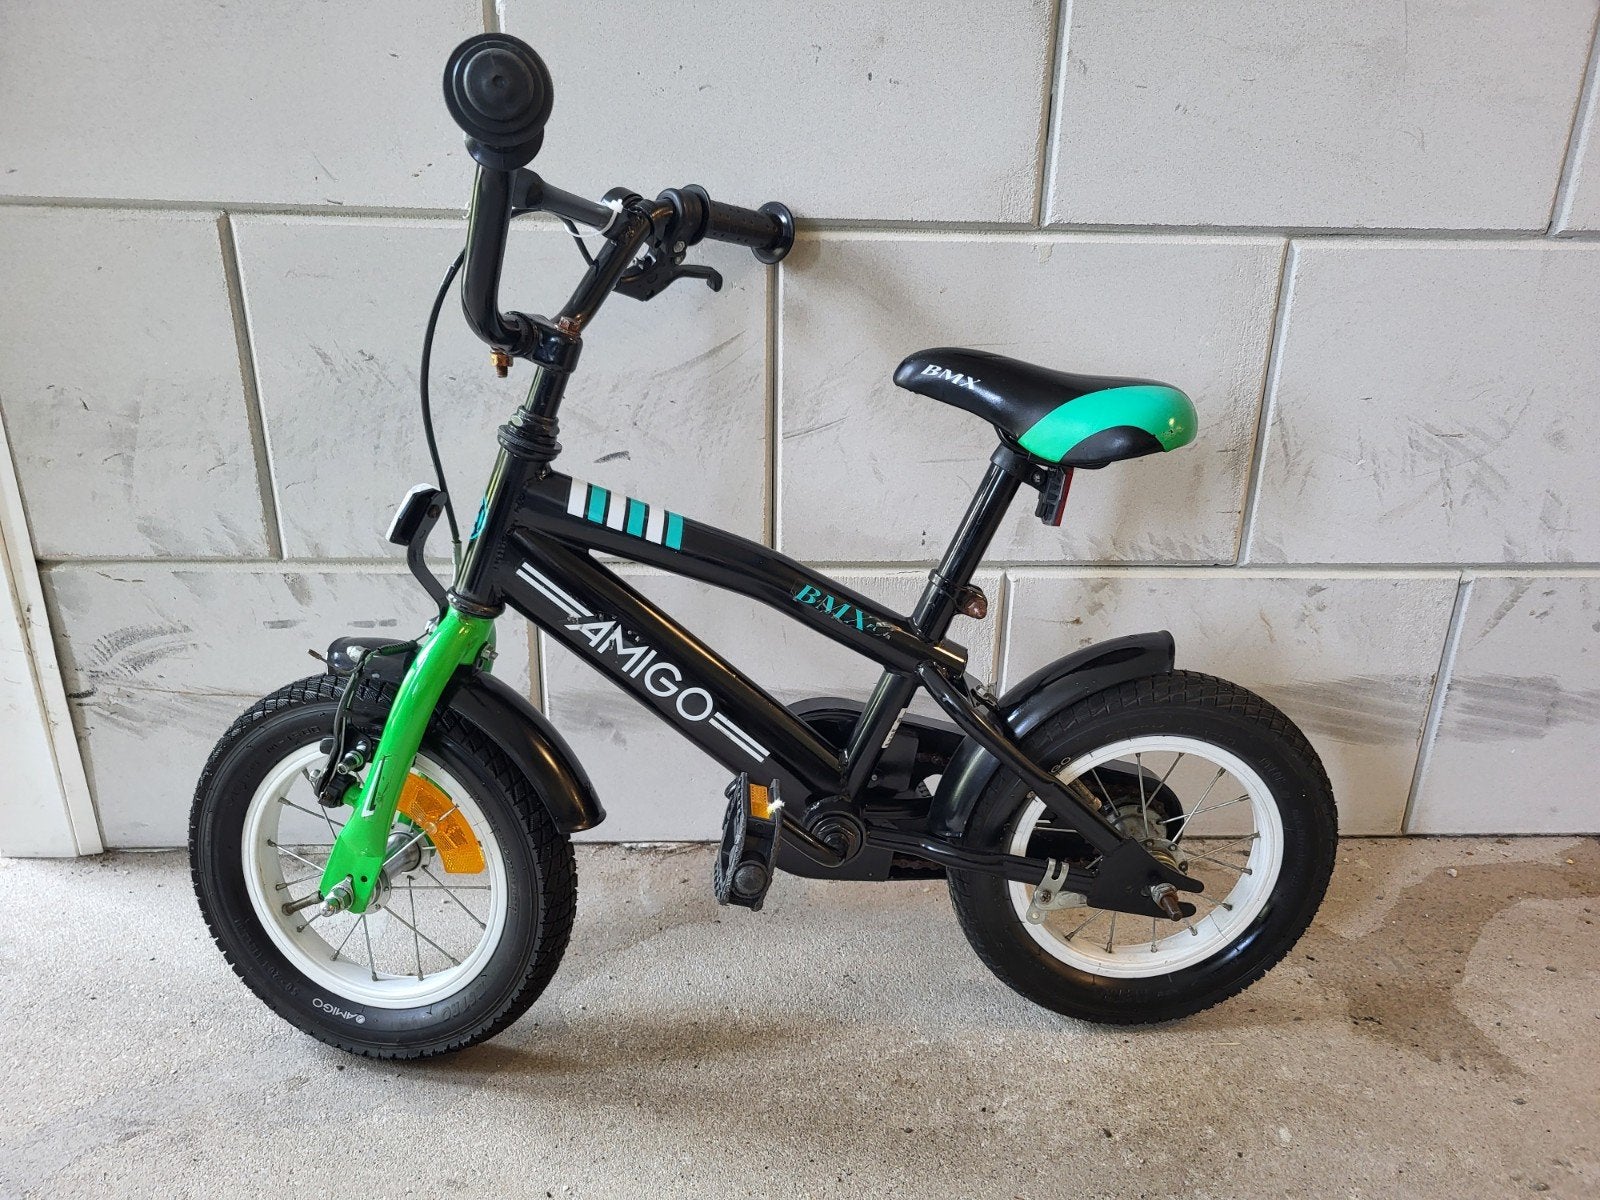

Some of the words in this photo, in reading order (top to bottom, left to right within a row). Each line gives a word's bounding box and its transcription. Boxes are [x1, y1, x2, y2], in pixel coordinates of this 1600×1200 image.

[921, 364, 981, 390] BMX
[794, 584, 869, 631] BMX
[564, 621, 713, 721] AMIGO
[312, 998, 357, 1020] AMIGO
